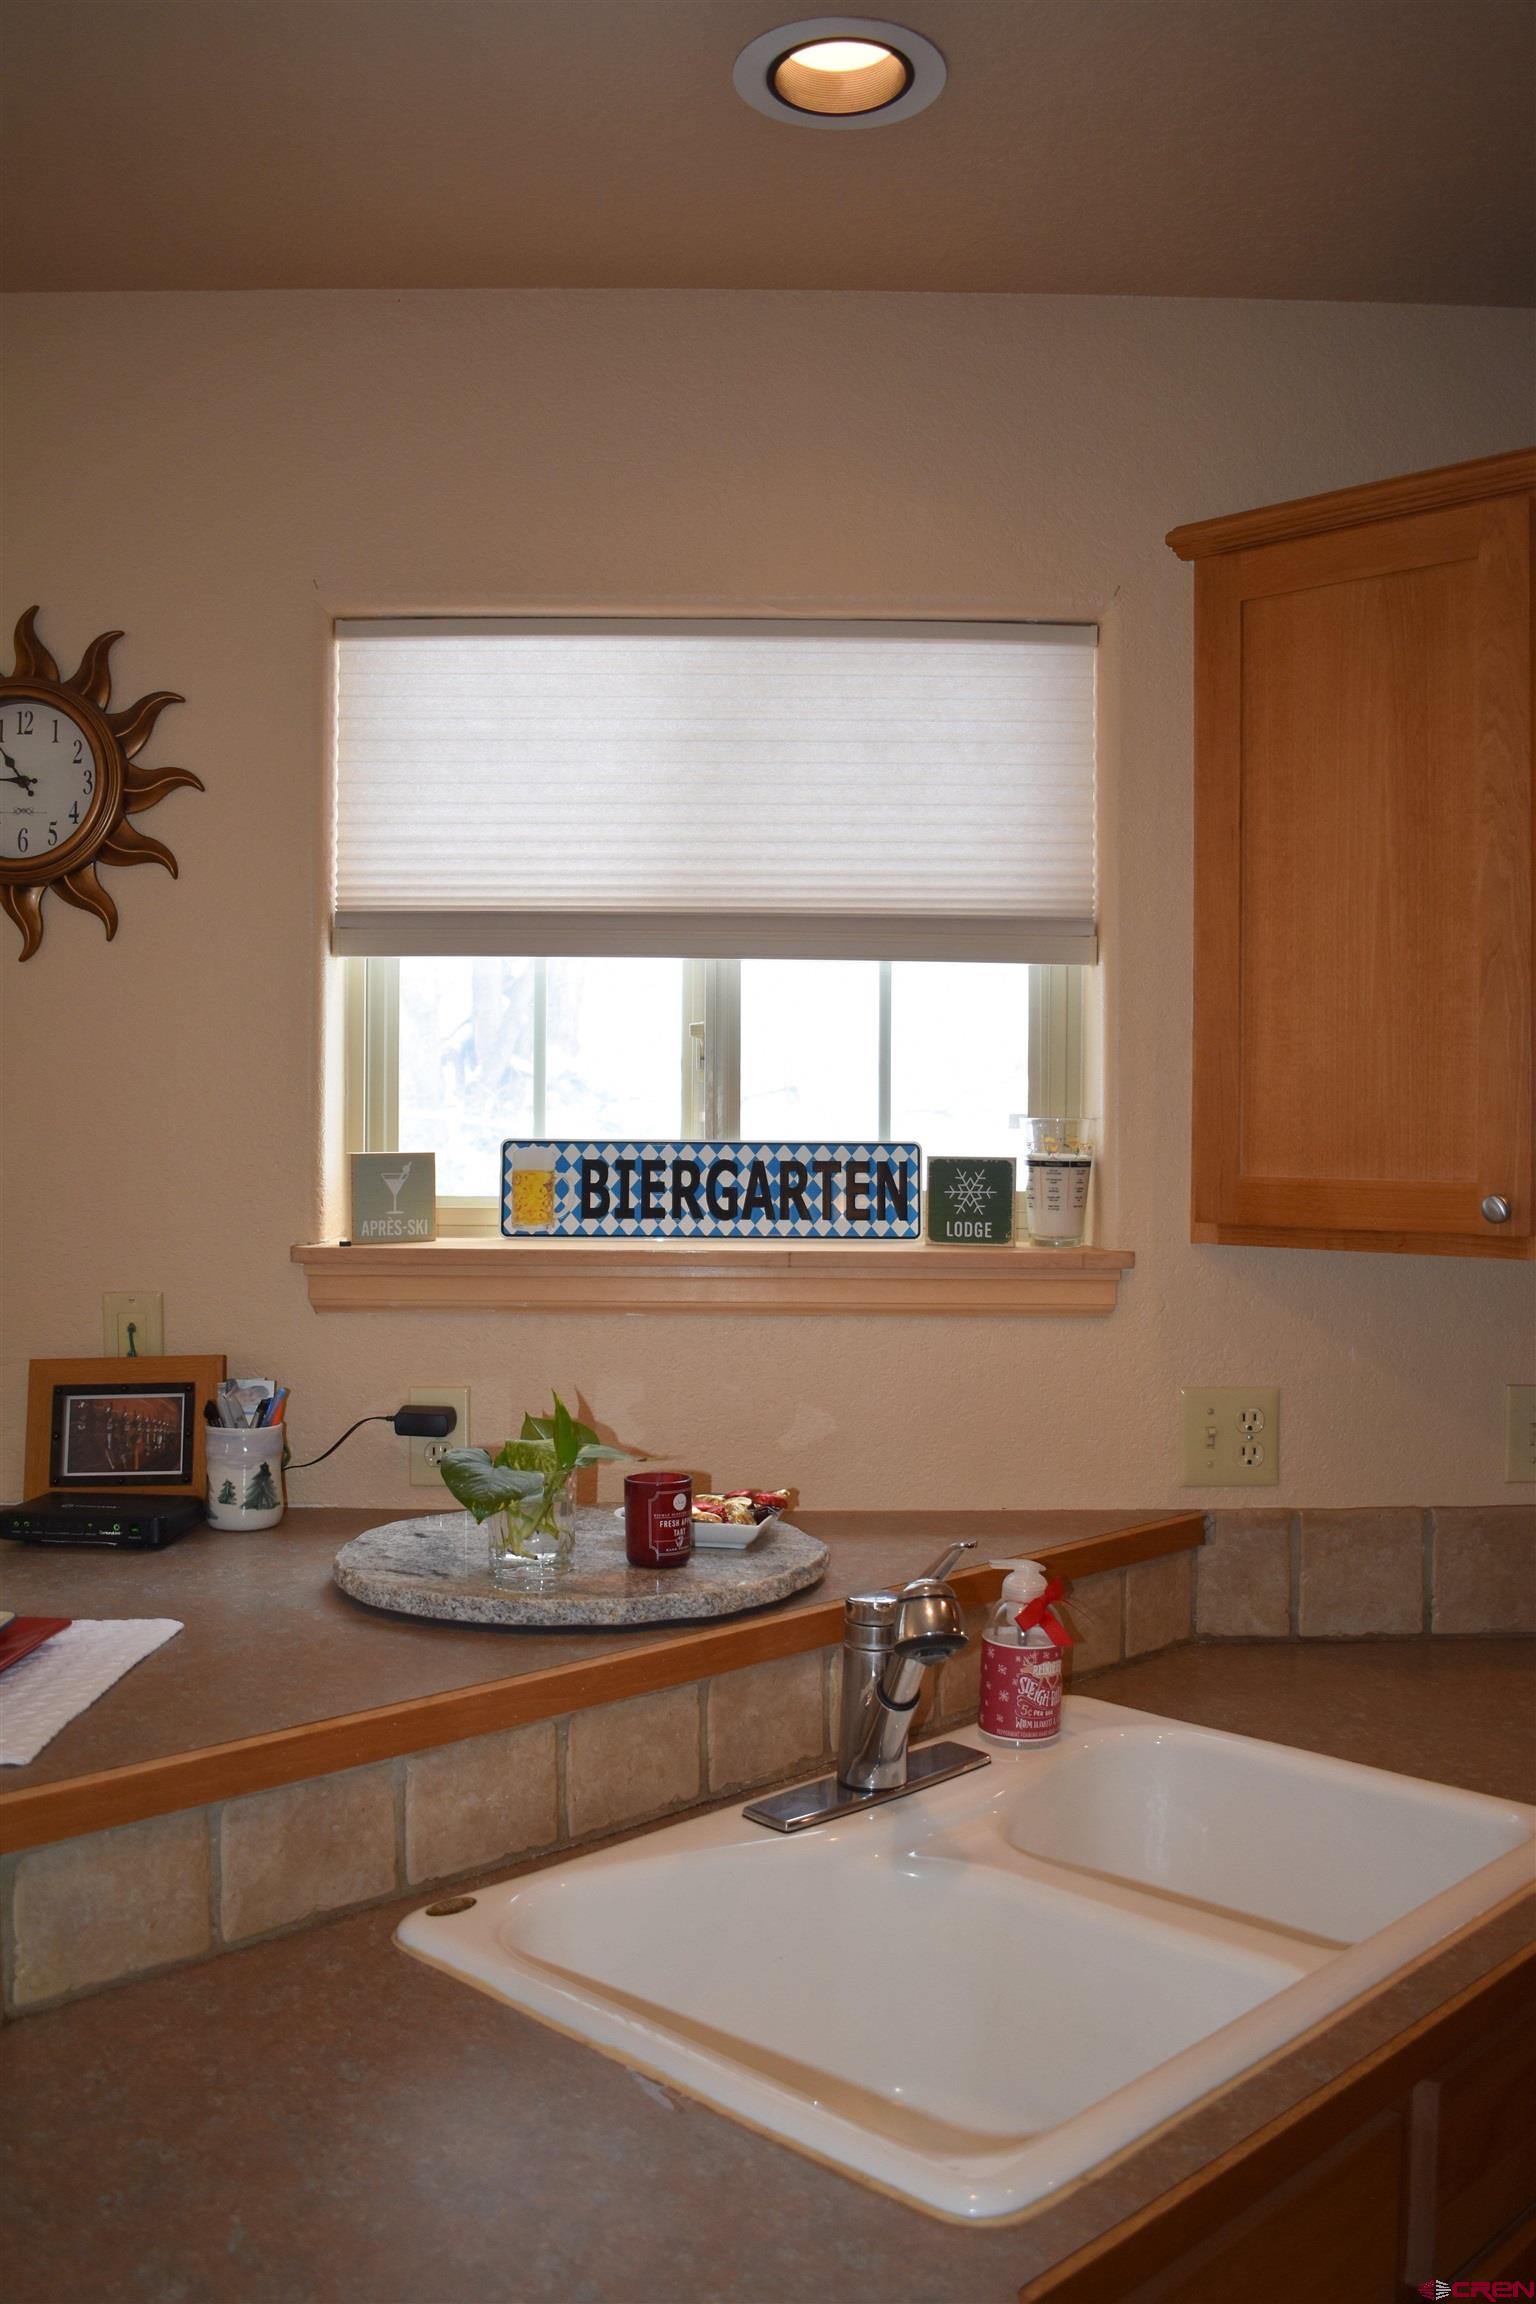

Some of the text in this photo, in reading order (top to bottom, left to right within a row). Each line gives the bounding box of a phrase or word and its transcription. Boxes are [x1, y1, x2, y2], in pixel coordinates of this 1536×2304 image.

[17, 710, 34, 735] 12
[52, 719, 59, 743] 1
[73, 739, 82, 764] 2
[83, 769, 93, 795] 3
[68, 800, 79, 825] 4
[17, 827, 29, 853] 6
[47, 821, 58, 846] 5
[581, 1158, 909, 1222] BIERGARTEN
[361, 1216, 429, 1238] APRÈS-SKI
[946, 1221, 993, 1239] LODGE
[659, 1519, 680, 1528] FRESH
[1018, 1677, 1050, 1706] SLEIGH
